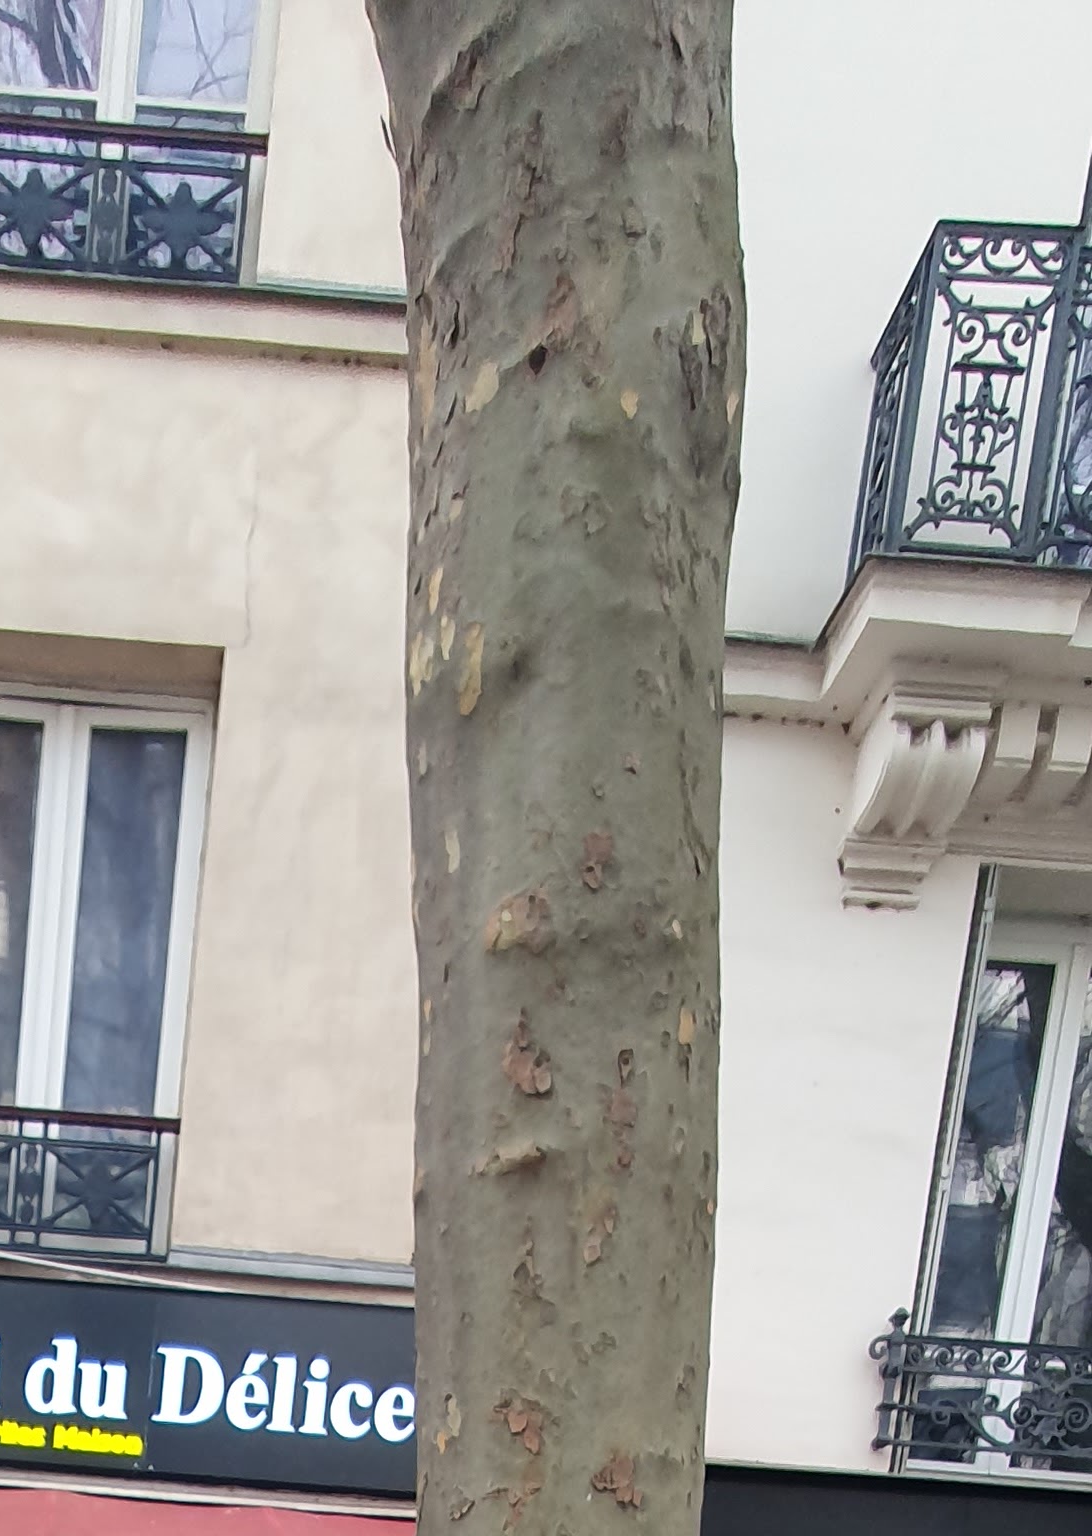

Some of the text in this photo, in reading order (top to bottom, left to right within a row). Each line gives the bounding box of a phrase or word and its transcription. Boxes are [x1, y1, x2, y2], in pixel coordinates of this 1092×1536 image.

[23, 1335, 128, 1420] du
[151, 1343, 415, 1444] Délice
[52, 1424, 144, 1456] Maison
